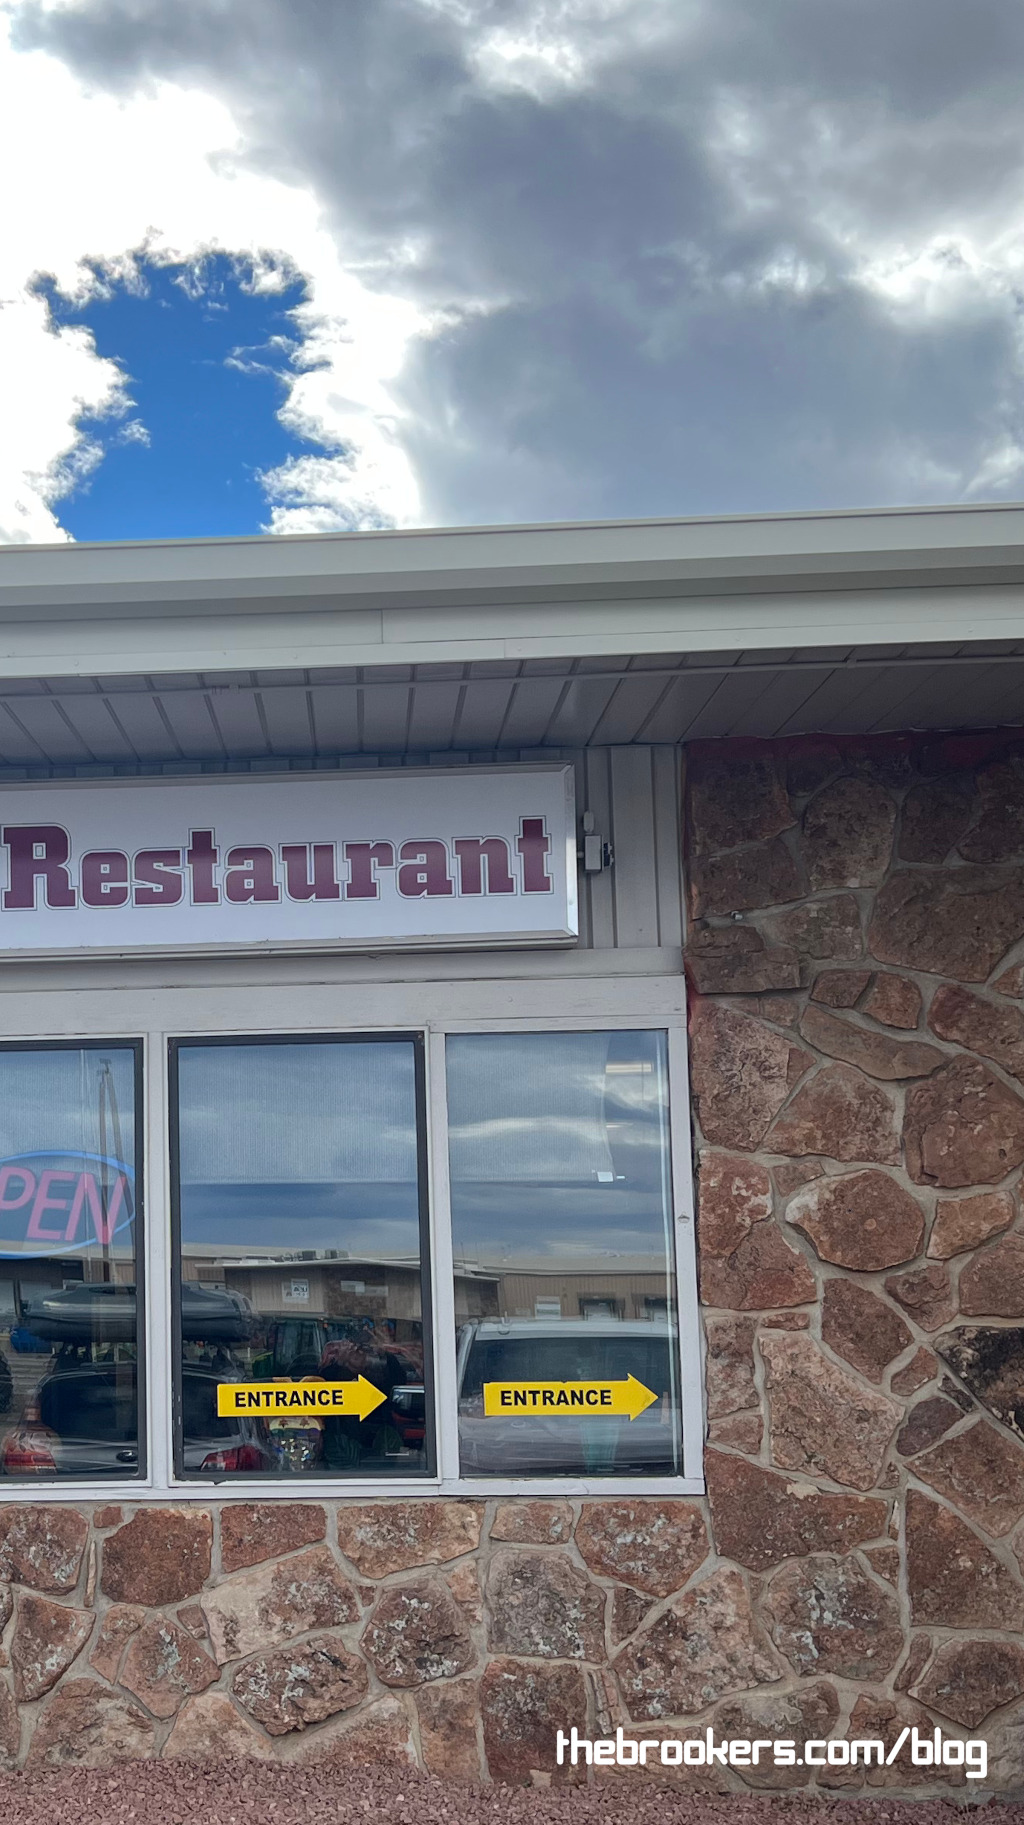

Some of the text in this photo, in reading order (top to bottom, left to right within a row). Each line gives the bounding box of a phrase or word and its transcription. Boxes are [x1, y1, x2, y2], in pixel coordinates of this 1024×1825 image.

[0, 815, 553, 912] Restaurant
[234, 1389, 344, 1408] ENTRANCE
[500, 1389, 613, 1407] ENTRANCE
